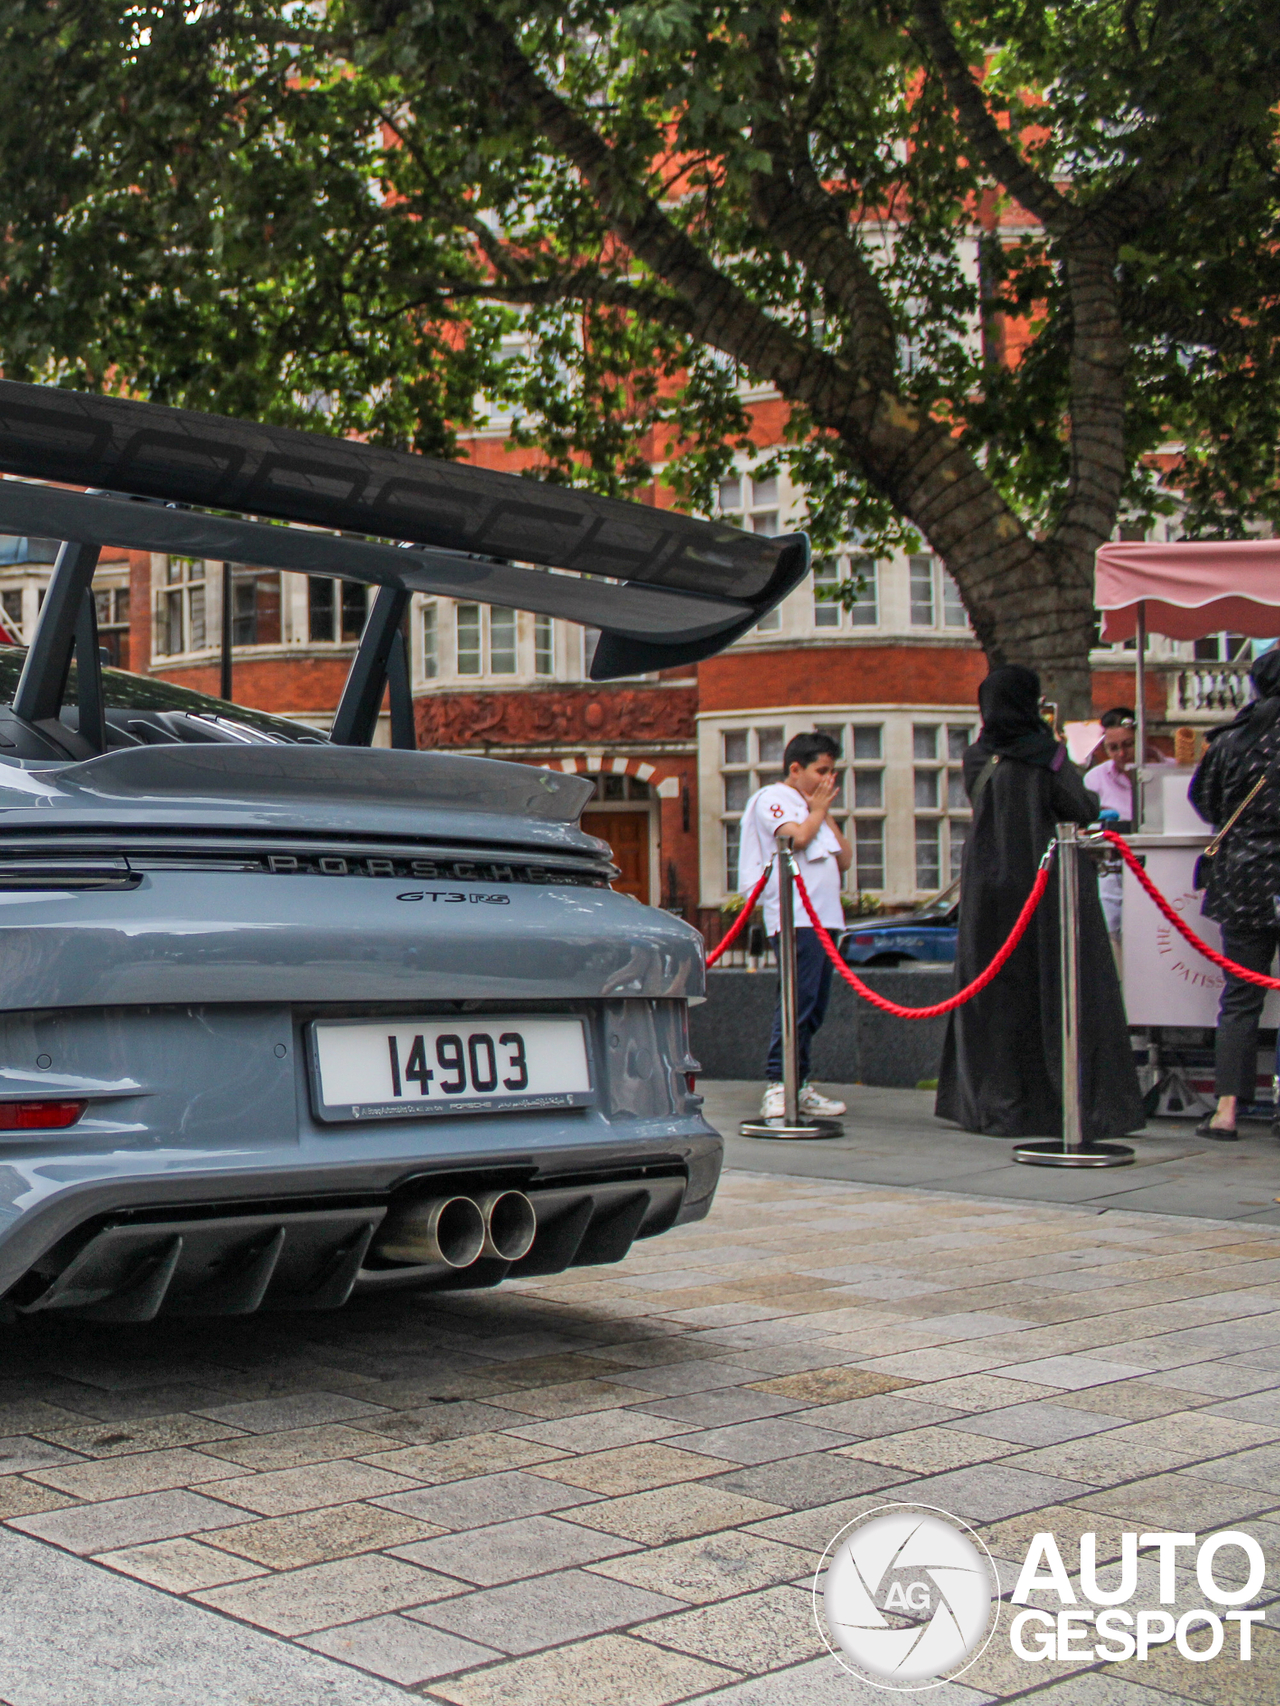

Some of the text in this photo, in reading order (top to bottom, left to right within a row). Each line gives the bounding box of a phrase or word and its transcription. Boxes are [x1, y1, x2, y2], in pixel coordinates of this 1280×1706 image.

[769, 803, 784, 819] 8
[267, 855, 546, 884] PORSCHE
[1156, 924, 1173, 955] THE
[387, 1032, 529, 1097] 14903
[449, 1101, 492, 1110] PORSCHE
